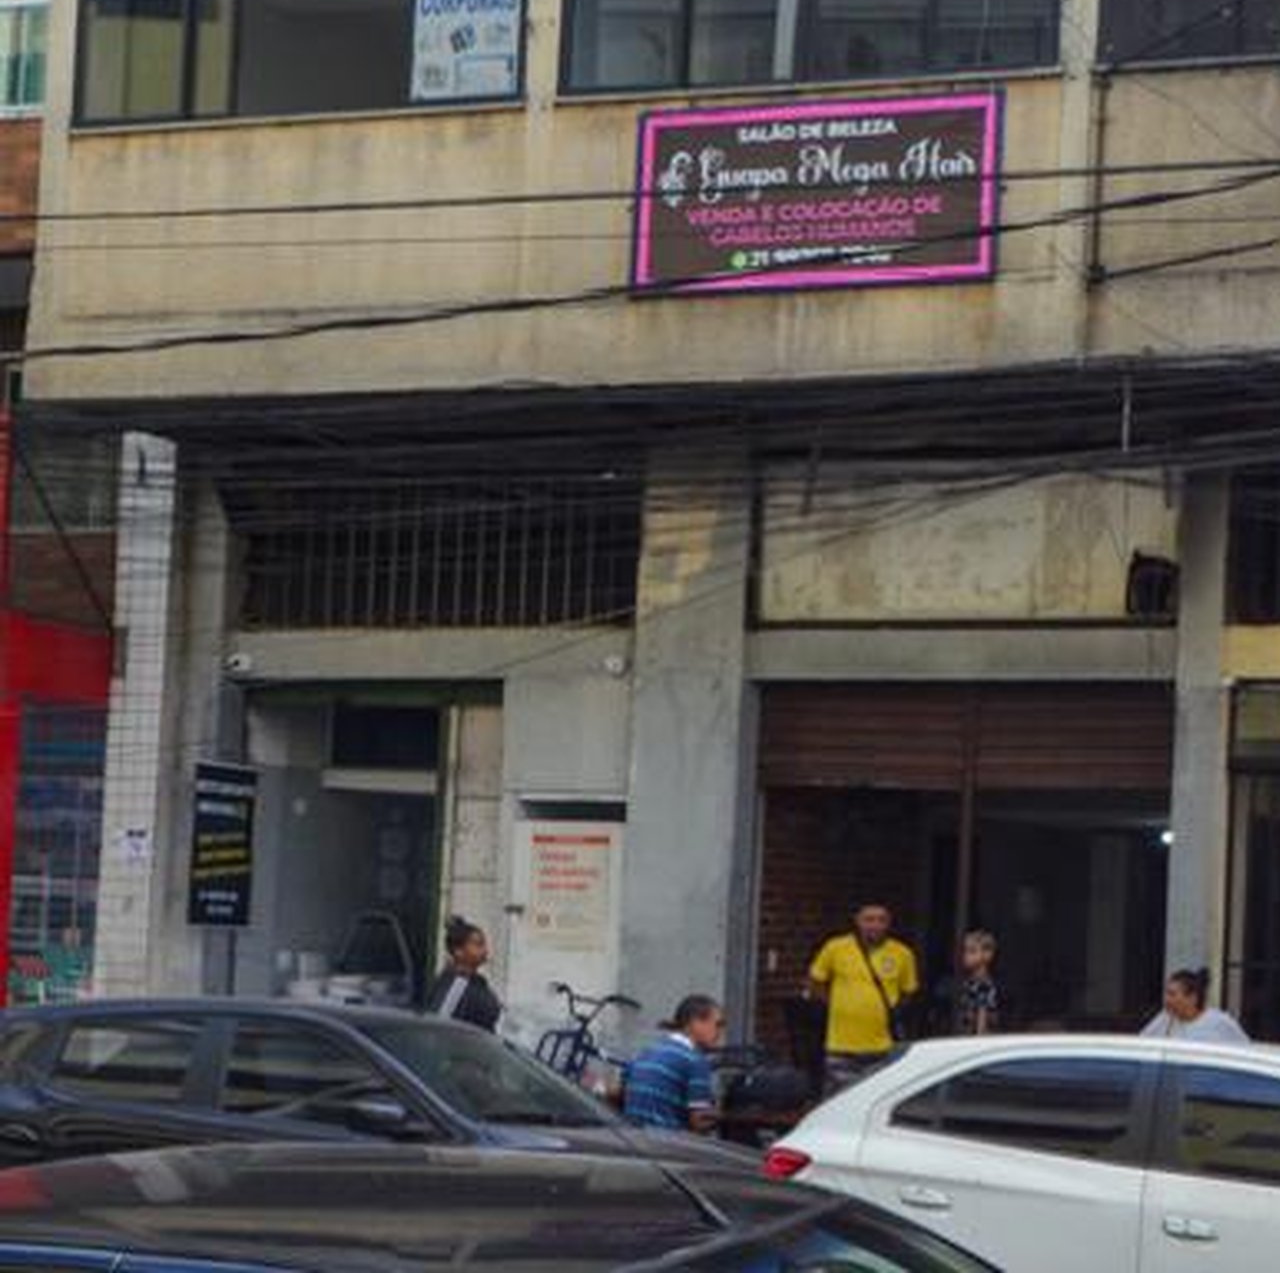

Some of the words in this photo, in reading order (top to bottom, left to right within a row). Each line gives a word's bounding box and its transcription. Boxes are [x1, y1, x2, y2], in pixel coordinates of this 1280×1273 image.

[737, 122, 795, 144] SALÃO
[800, 122, 823, 139] DE
[828, 119, 898, 137] BELEZA
[798, 143, 889, 196] Mega
[898, 137, 976, 181] Hair
[687, 202, 756, 224] VENDA
[761, 203, 773, 221] E
[914, 195, 942, 214] DE
